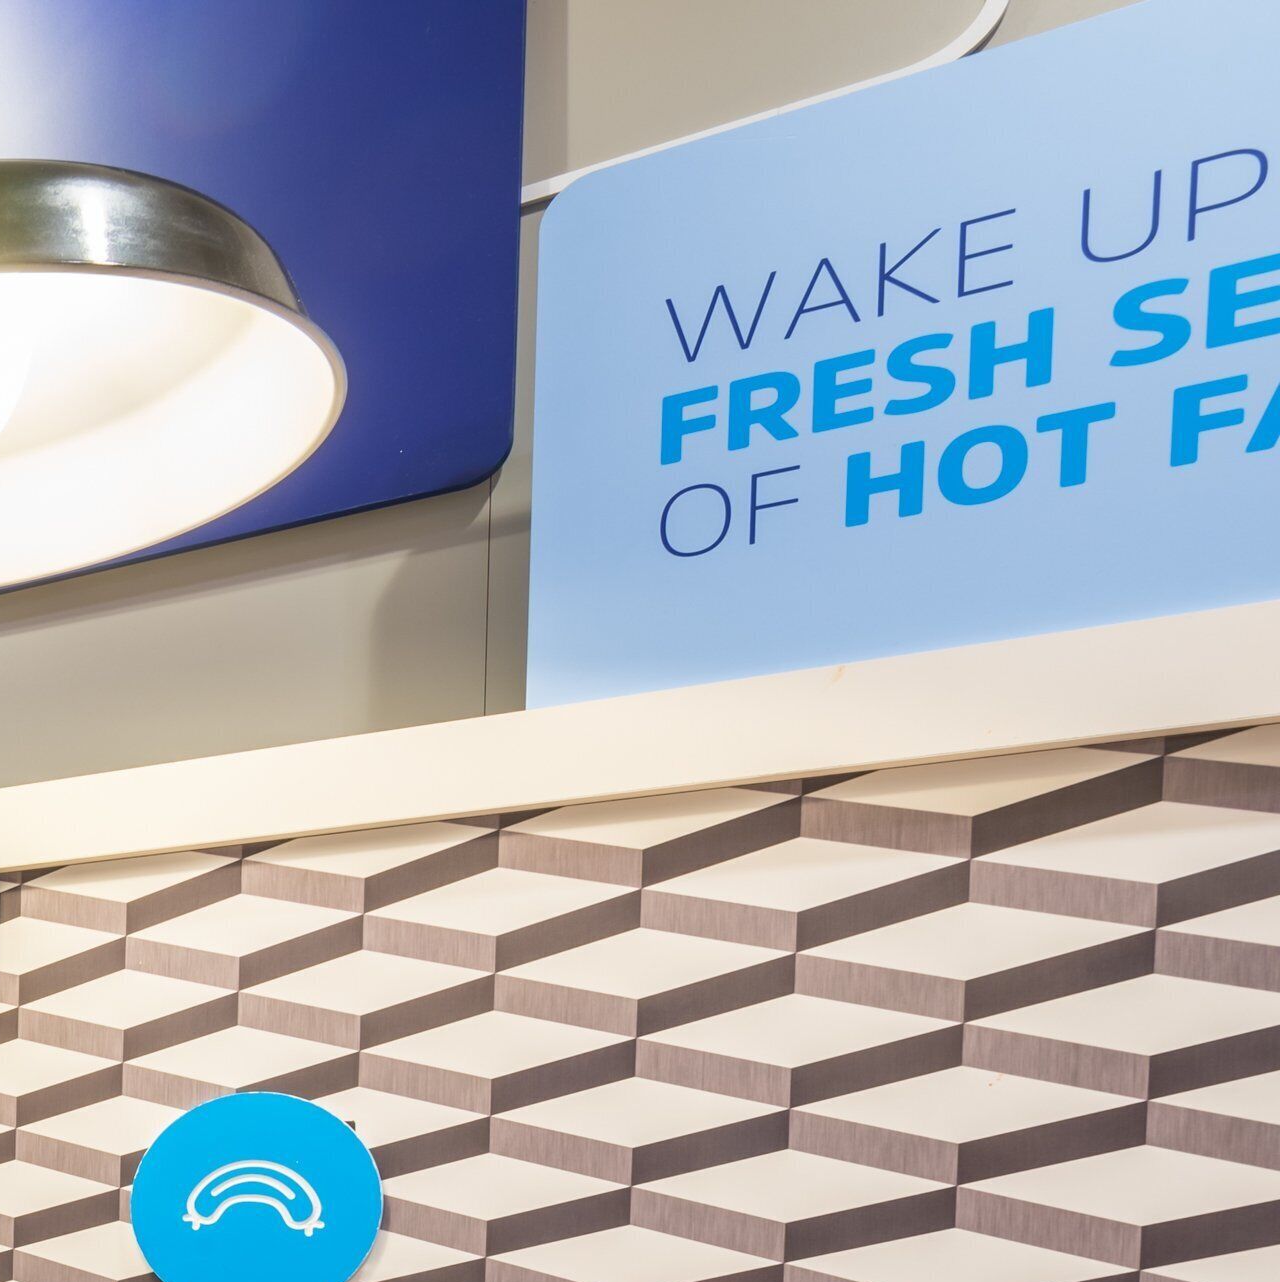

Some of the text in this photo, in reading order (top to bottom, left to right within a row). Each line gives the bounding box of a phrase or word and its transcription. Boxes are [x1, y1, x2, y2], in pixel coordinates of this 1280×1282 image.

[665, 148, 1268, 363] WAKE UP
[660, 307, 1054, 466] FRESH
[660, 465, 800, 557] OF
[845, 401, 1116, 528] HOT
